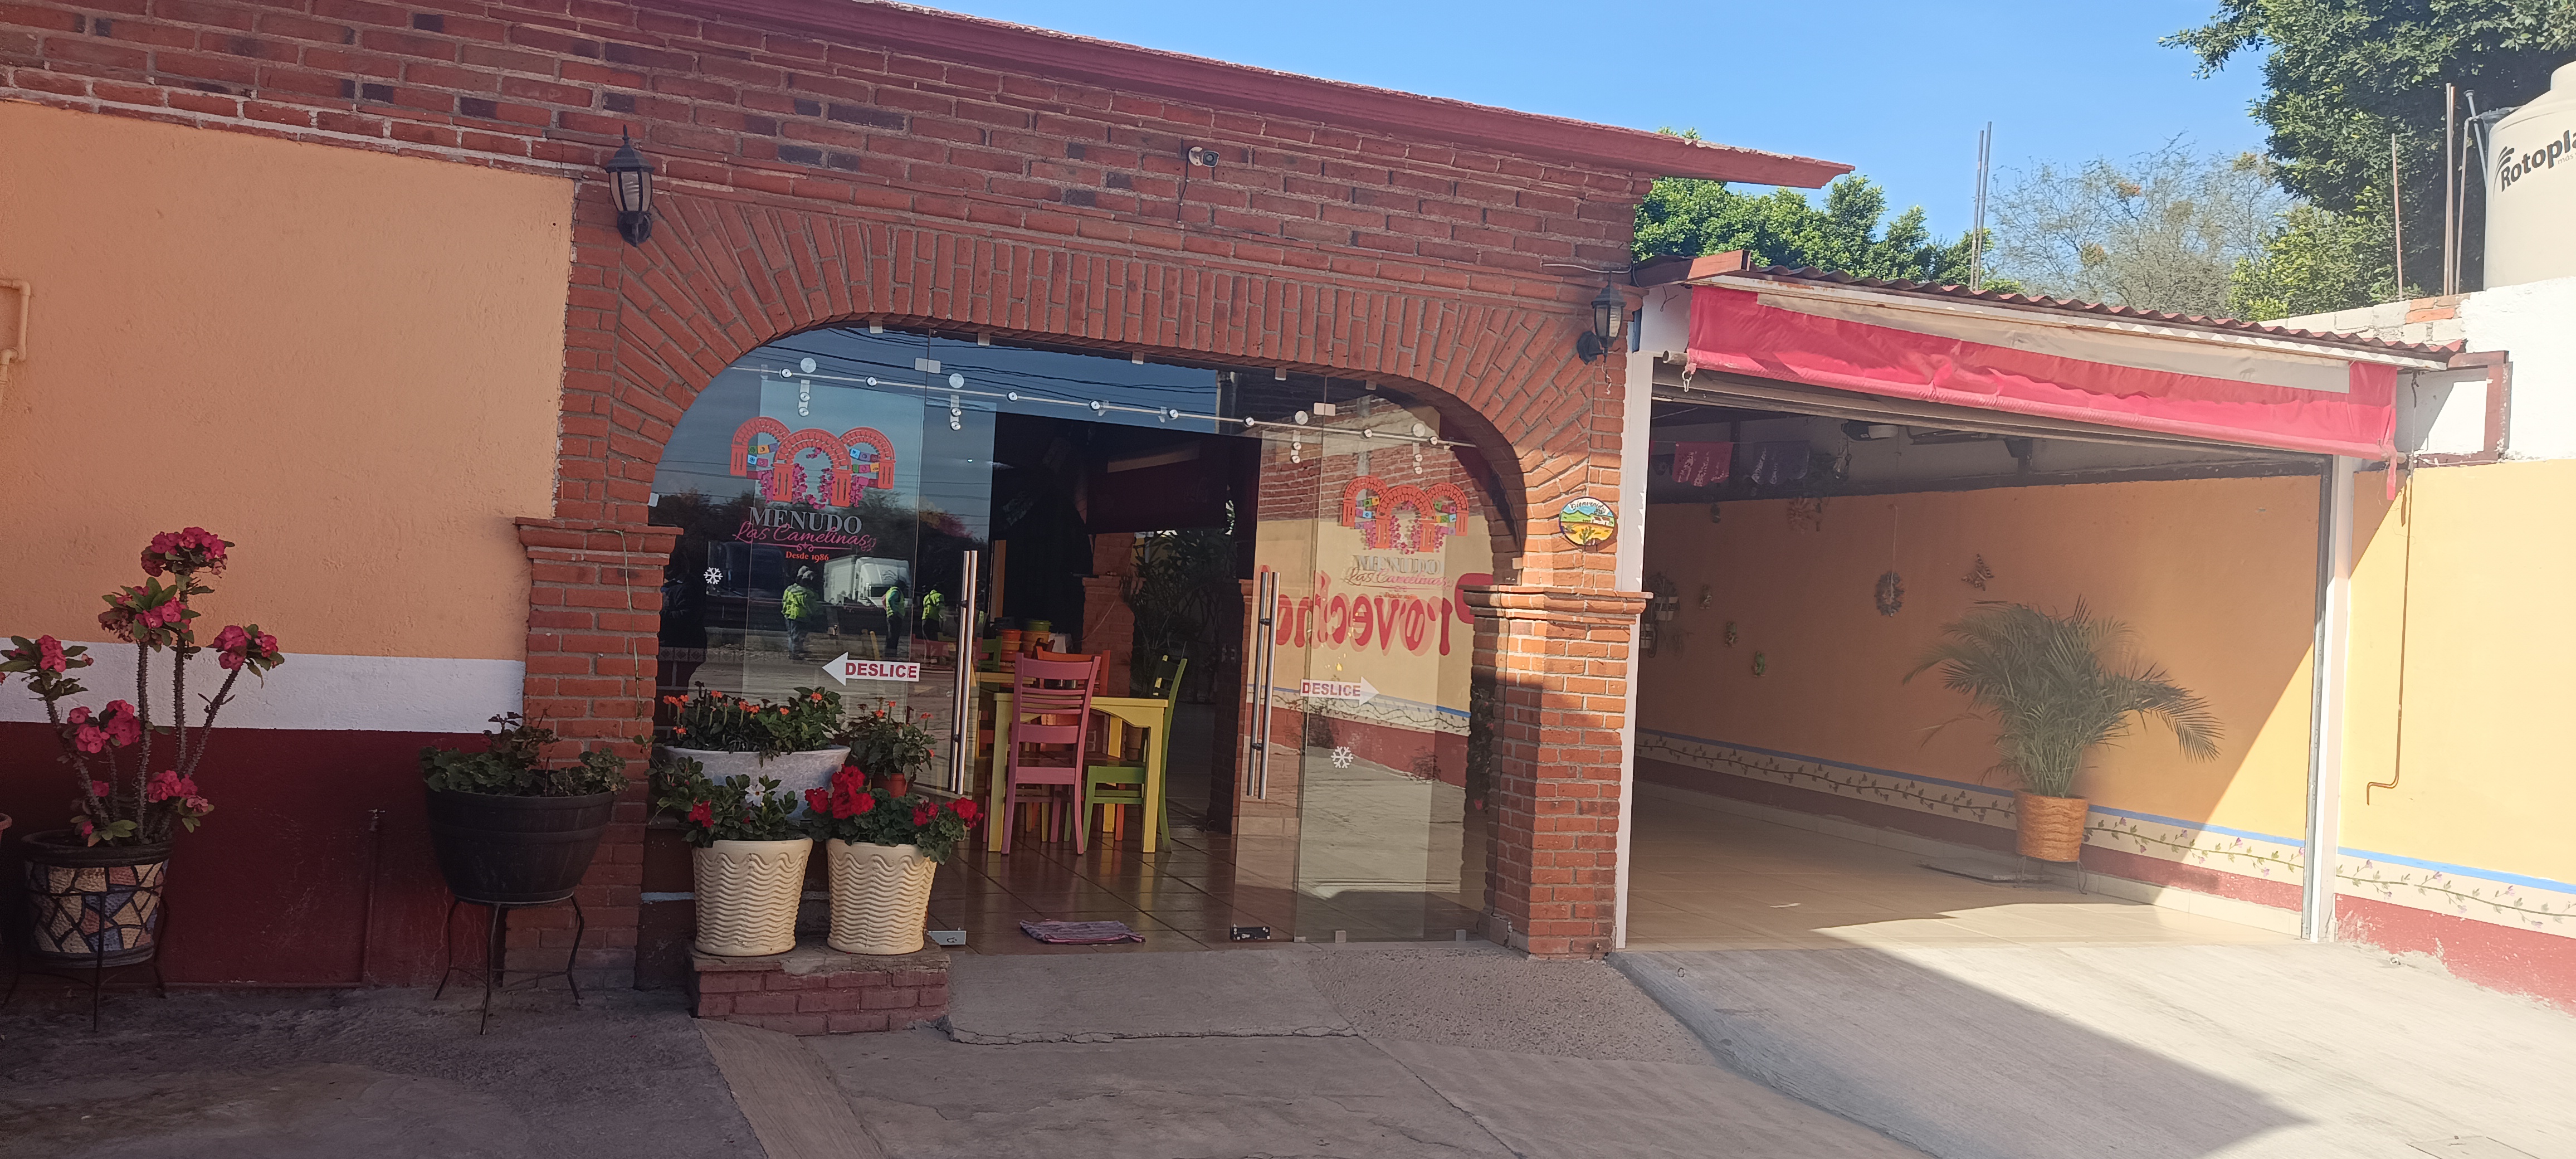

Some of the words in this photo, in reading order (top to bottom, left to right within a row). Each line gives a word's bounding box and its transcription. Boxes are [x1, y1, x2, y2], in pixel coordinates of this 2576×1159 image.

[748, 507, 862, 534] MENUDO
[732, 520, 770, 544] Las
[773, 523, 874, 549] Camelinas
[785, 551, 809, 560] Desde
[811, 553, 830, 563] 1986
[845, 662, 917, 678] DESLICE
[1302, 682, 1361, 697] DESLICE
